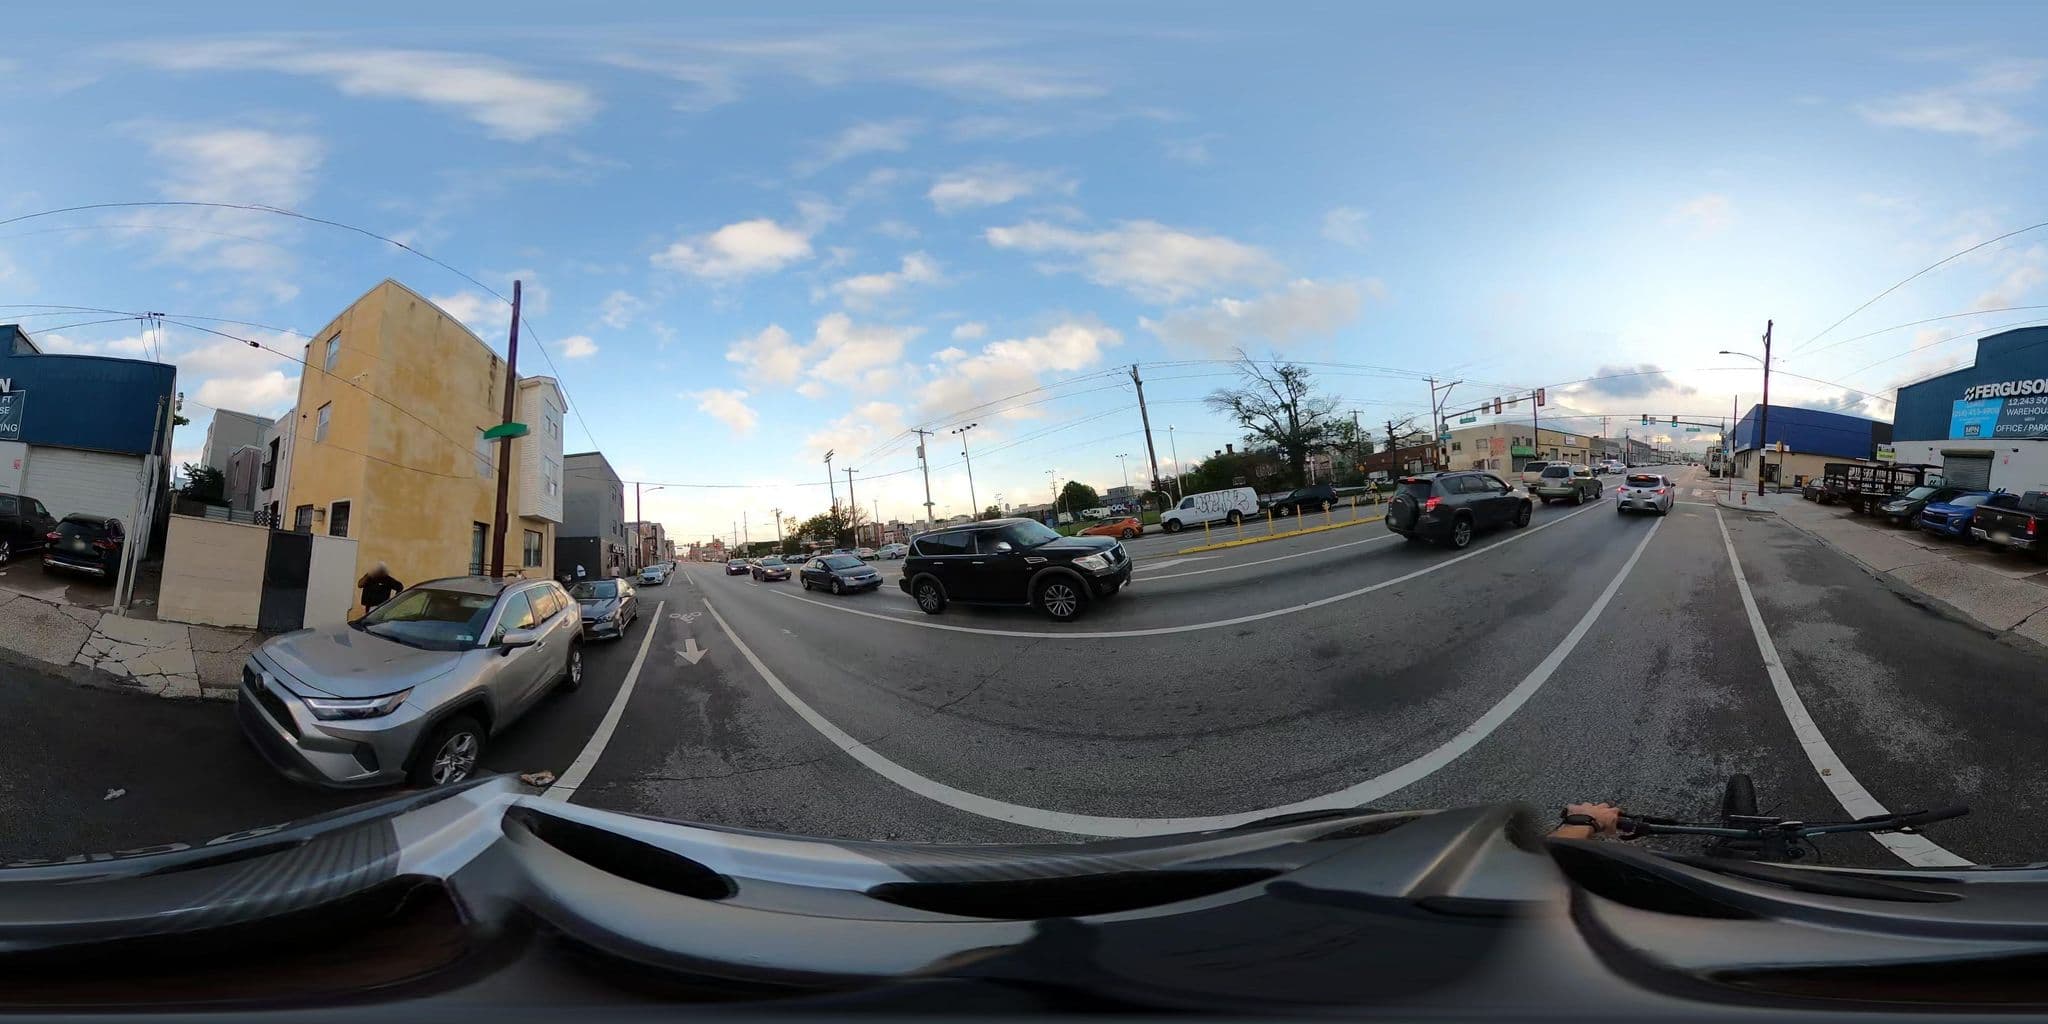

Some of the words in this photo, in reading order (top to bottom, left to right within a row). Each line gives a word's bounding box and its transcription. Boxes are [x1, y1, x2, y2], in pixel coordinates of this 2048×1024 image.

[1975, 379, 2048, 399] FERGUSO
[2, 396, 13, 404] FT
[2008, 397, 2035, 406] 12,243
[2036, 396, 2048, 405] SQ
[2006, 407, 2048, 416] WAREHOU
[0, 424, 18, 432] ING
